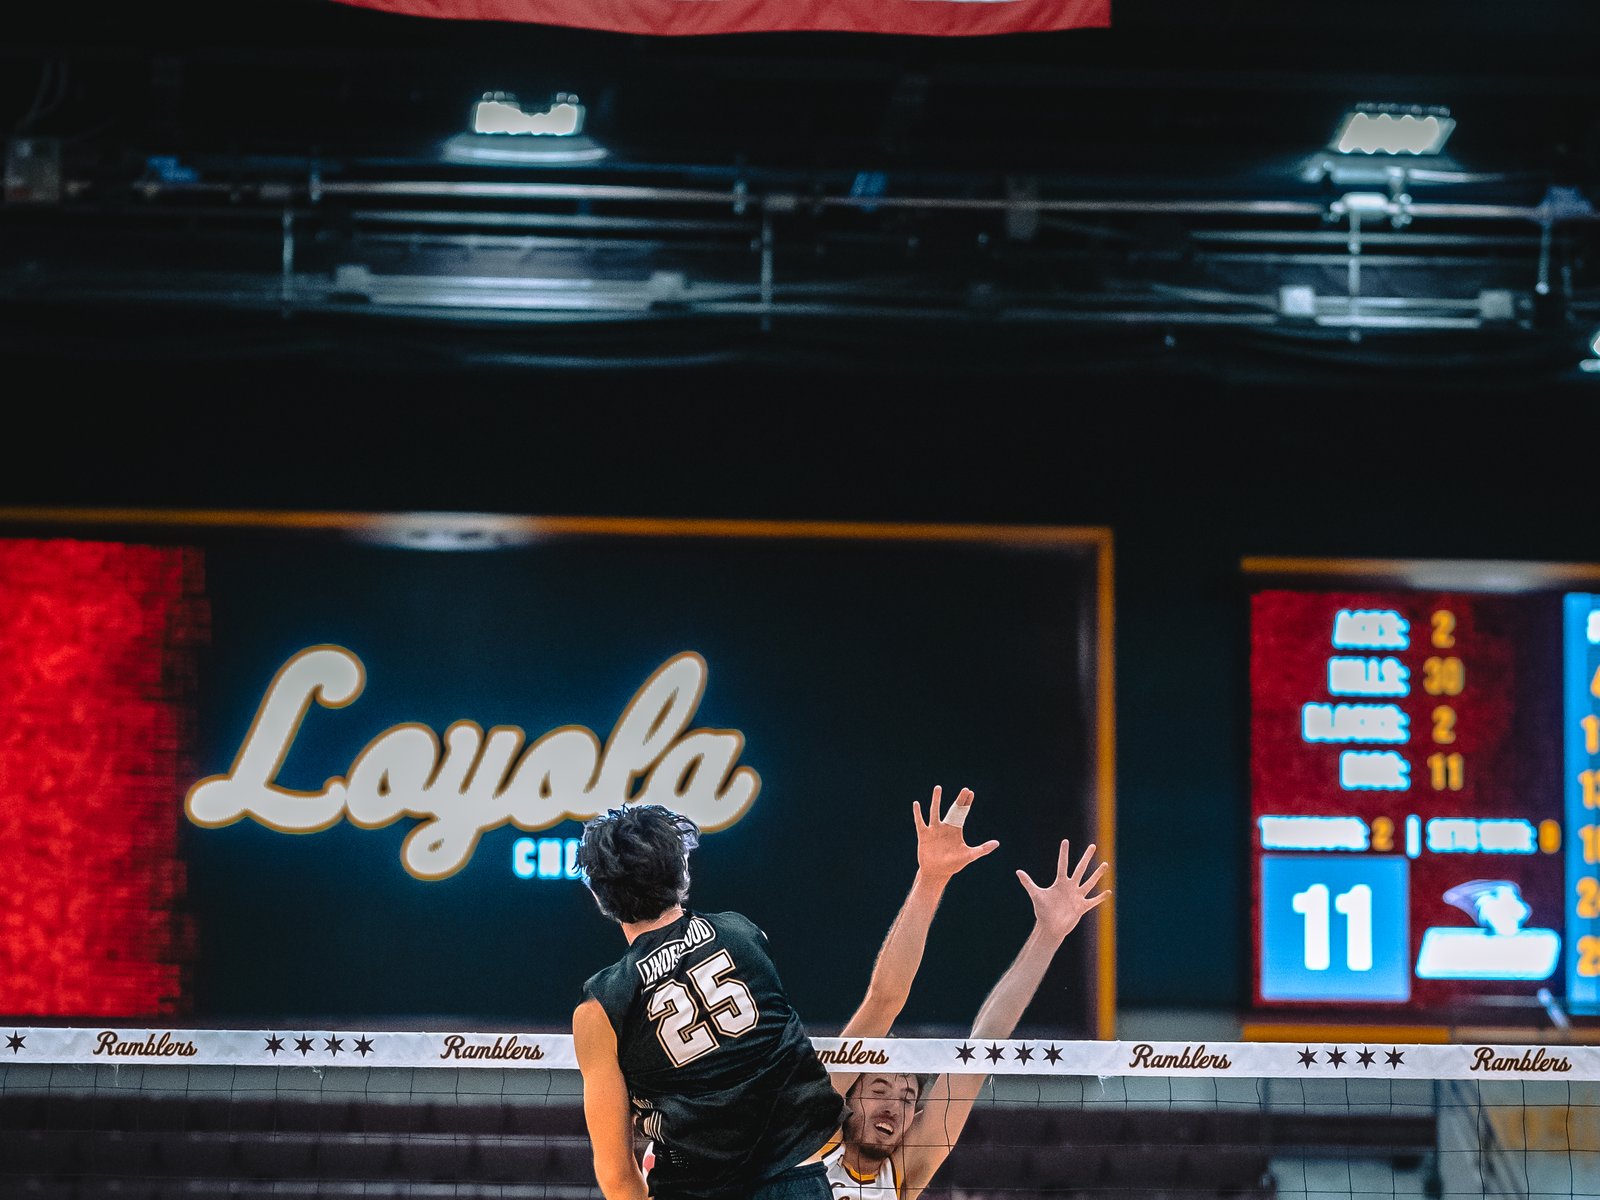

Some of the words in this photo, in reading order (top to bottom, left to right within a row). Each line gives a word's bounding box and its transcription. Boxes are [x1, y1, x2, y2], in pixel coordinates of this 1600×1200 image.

[1431, 610, 1456, 648] 2
[1432, 705, 1456, 744] 2
[185, 644, 761, 880] Loyola
[1427, 752, 1464, 791] 11
[1293, 884, 1373, 971] 11
[648, 949, 759, 1068] 25
[93, 1031, 198, 1057] Ramblers
[440, 1035, 545, 1061] Ramblers
[815, 1040, 889, 1064] mblers
[1129, 1043, 1232, 1070] Ramblers
[1469, 1046, 1573, 1073] Ramblers
